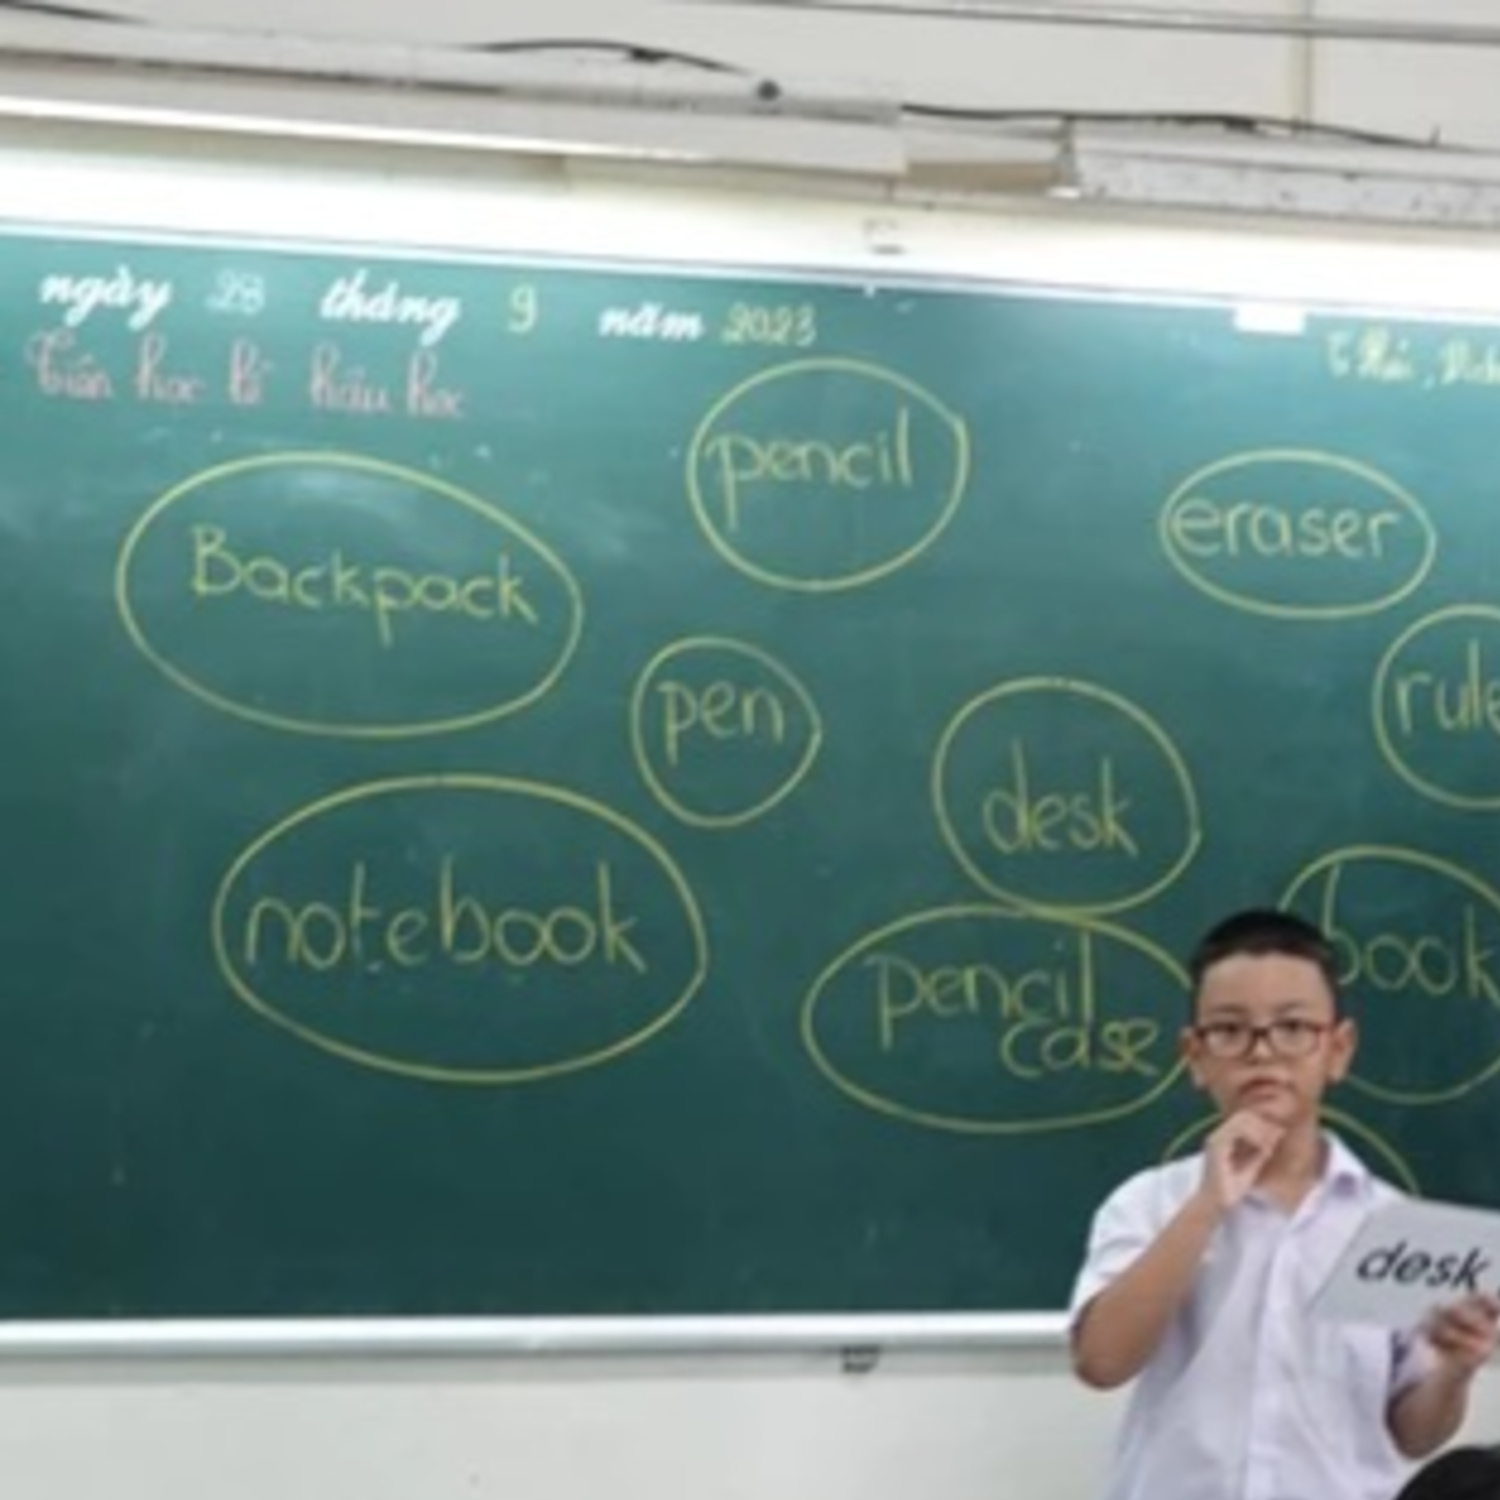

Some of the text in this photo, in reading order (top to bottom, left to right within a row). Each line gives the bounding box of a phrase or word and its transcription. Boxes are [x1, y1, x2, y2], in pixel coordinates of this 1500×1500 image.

[319, 267, 463, 347] tháng
[507, 285, 539, 334] 9
[599, 301, 705, 342] năm
[704, 408, 916, 532] pencil
[1170, 500, 1400, 558] eraser
[190, 525, 538, 648] Backpack
[656, 680, 785, 765] pen
[983, 740, 1138, 857] desk
[244, 855, 648, 974] notebook
[864, 930, 1095, 1050] pencil
[1001, 1018, 1159, 1078] case
[1357, 1238, 1492, 1292] desk
